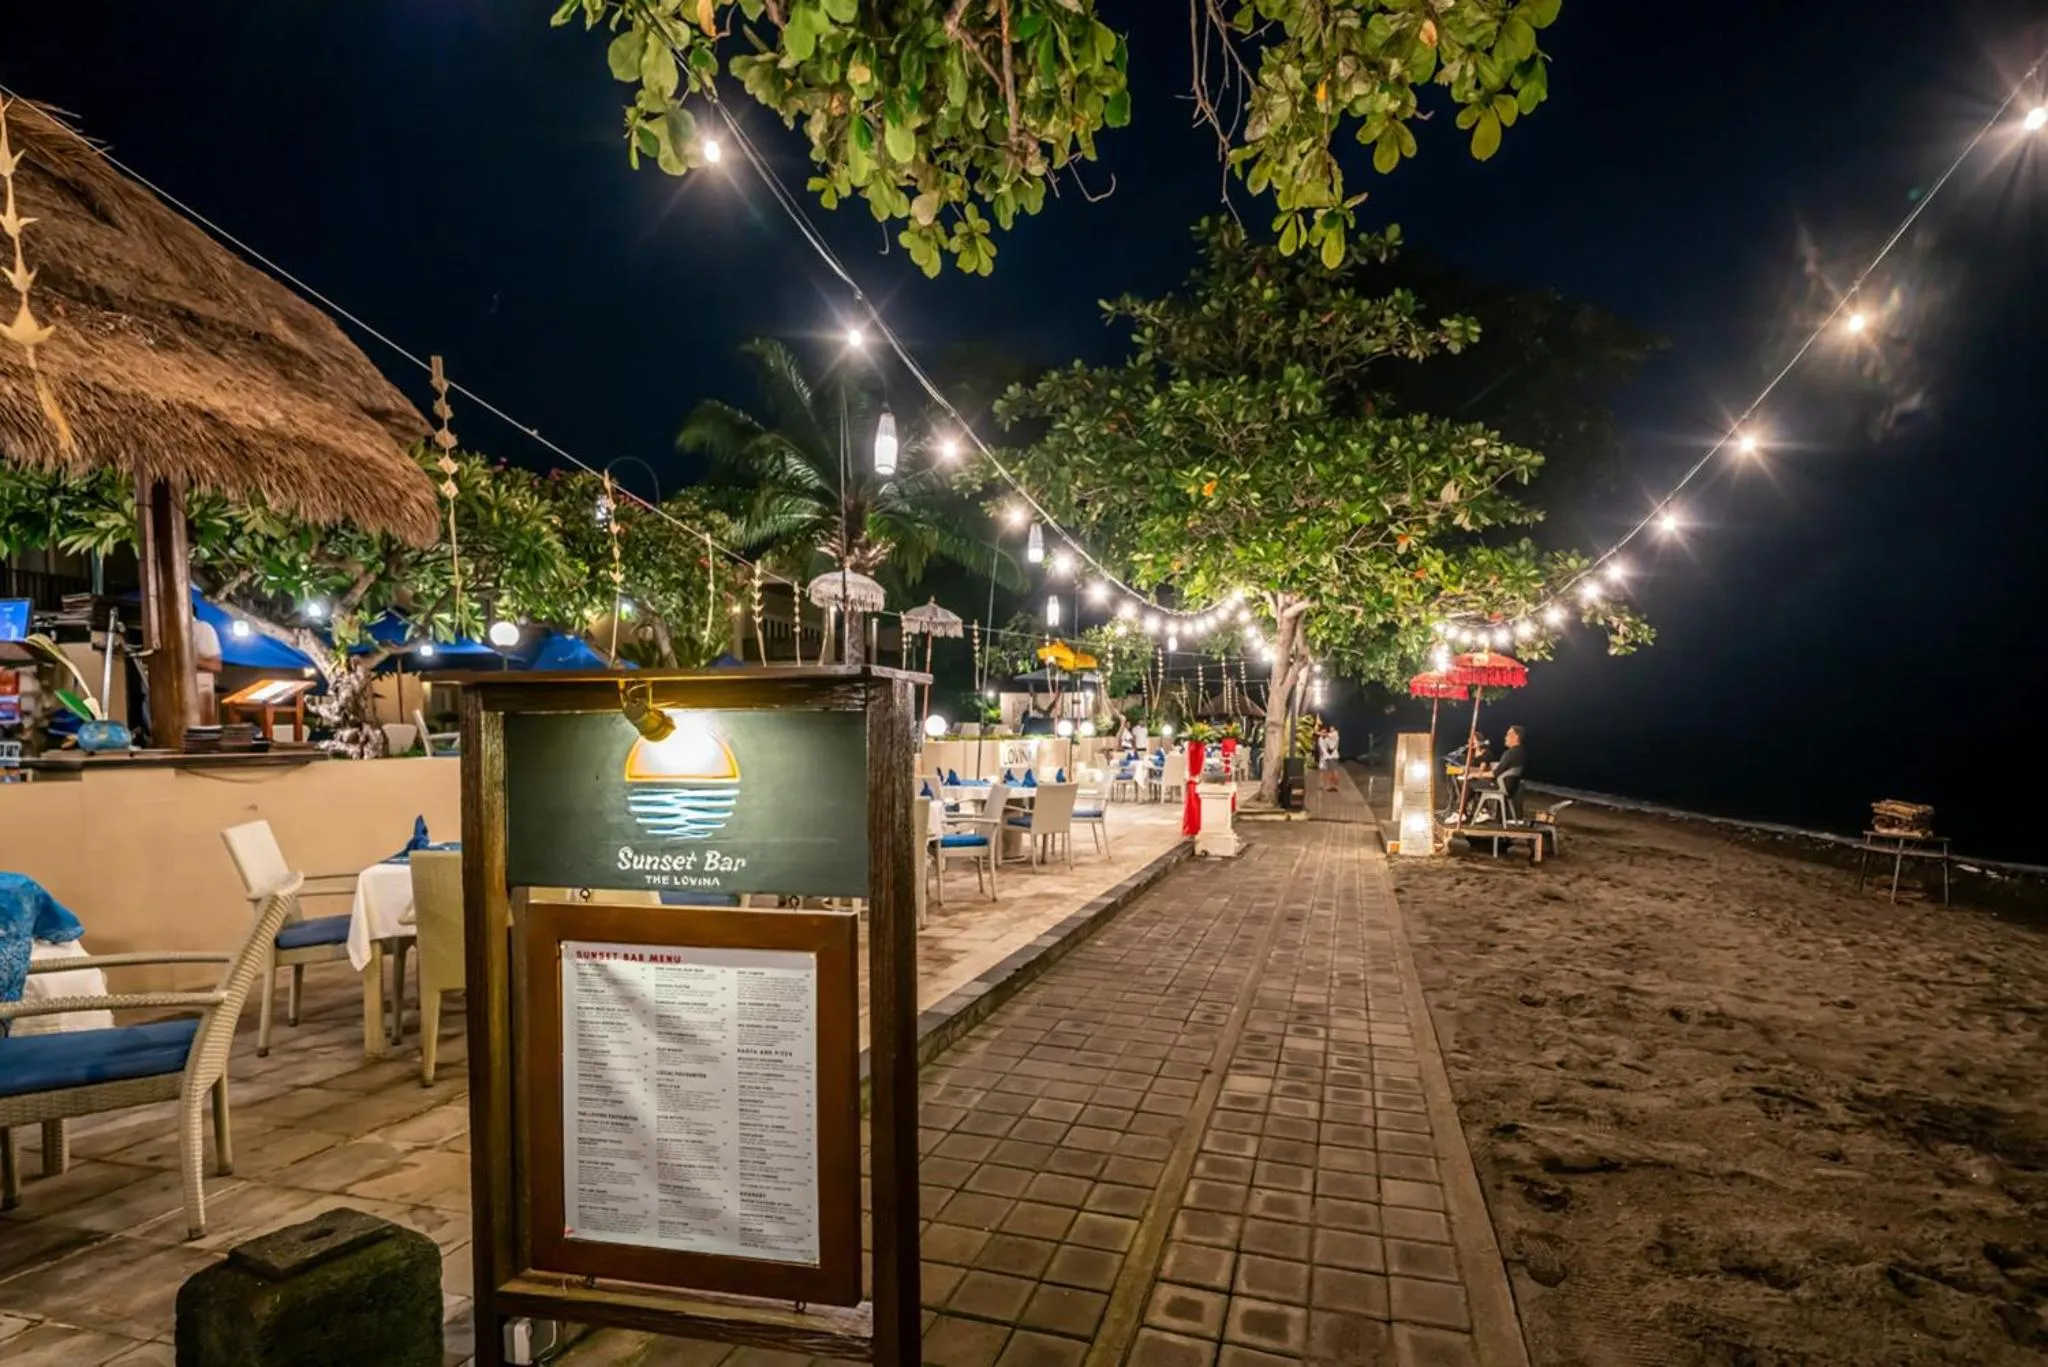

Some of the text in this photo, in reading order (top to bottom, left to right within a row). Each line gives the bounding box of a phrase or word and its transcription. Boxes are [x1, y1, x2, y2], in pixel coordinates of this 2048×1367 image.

[617, 846, 747, 872] Sunset Bar
[645, 874, 721, 887] THE LOVINA
[575, 949, 682, 964] SUNSET BAR MENU
